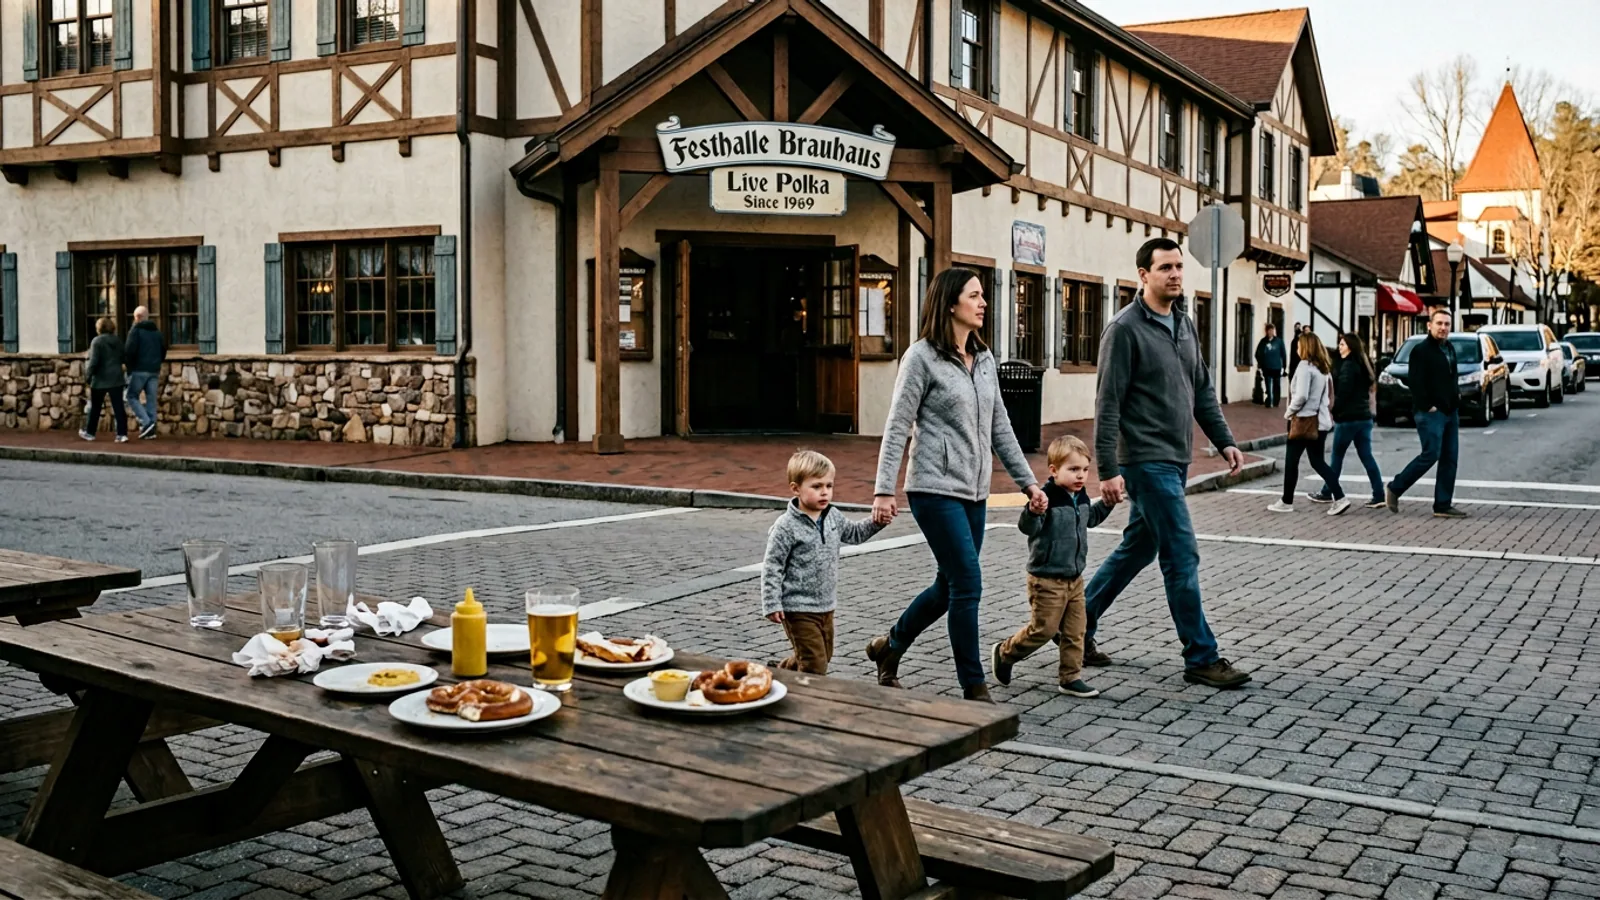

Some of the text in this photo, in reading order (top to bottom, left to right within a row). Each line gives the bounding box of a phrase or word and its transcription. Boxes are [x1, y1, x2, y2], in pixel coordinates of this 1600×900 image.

[669, 128, 882, 169] Festhalle Brauhaus
[727, 171, 830, 194] Live Polka
[743, 194, 815, 210] Since 1969
